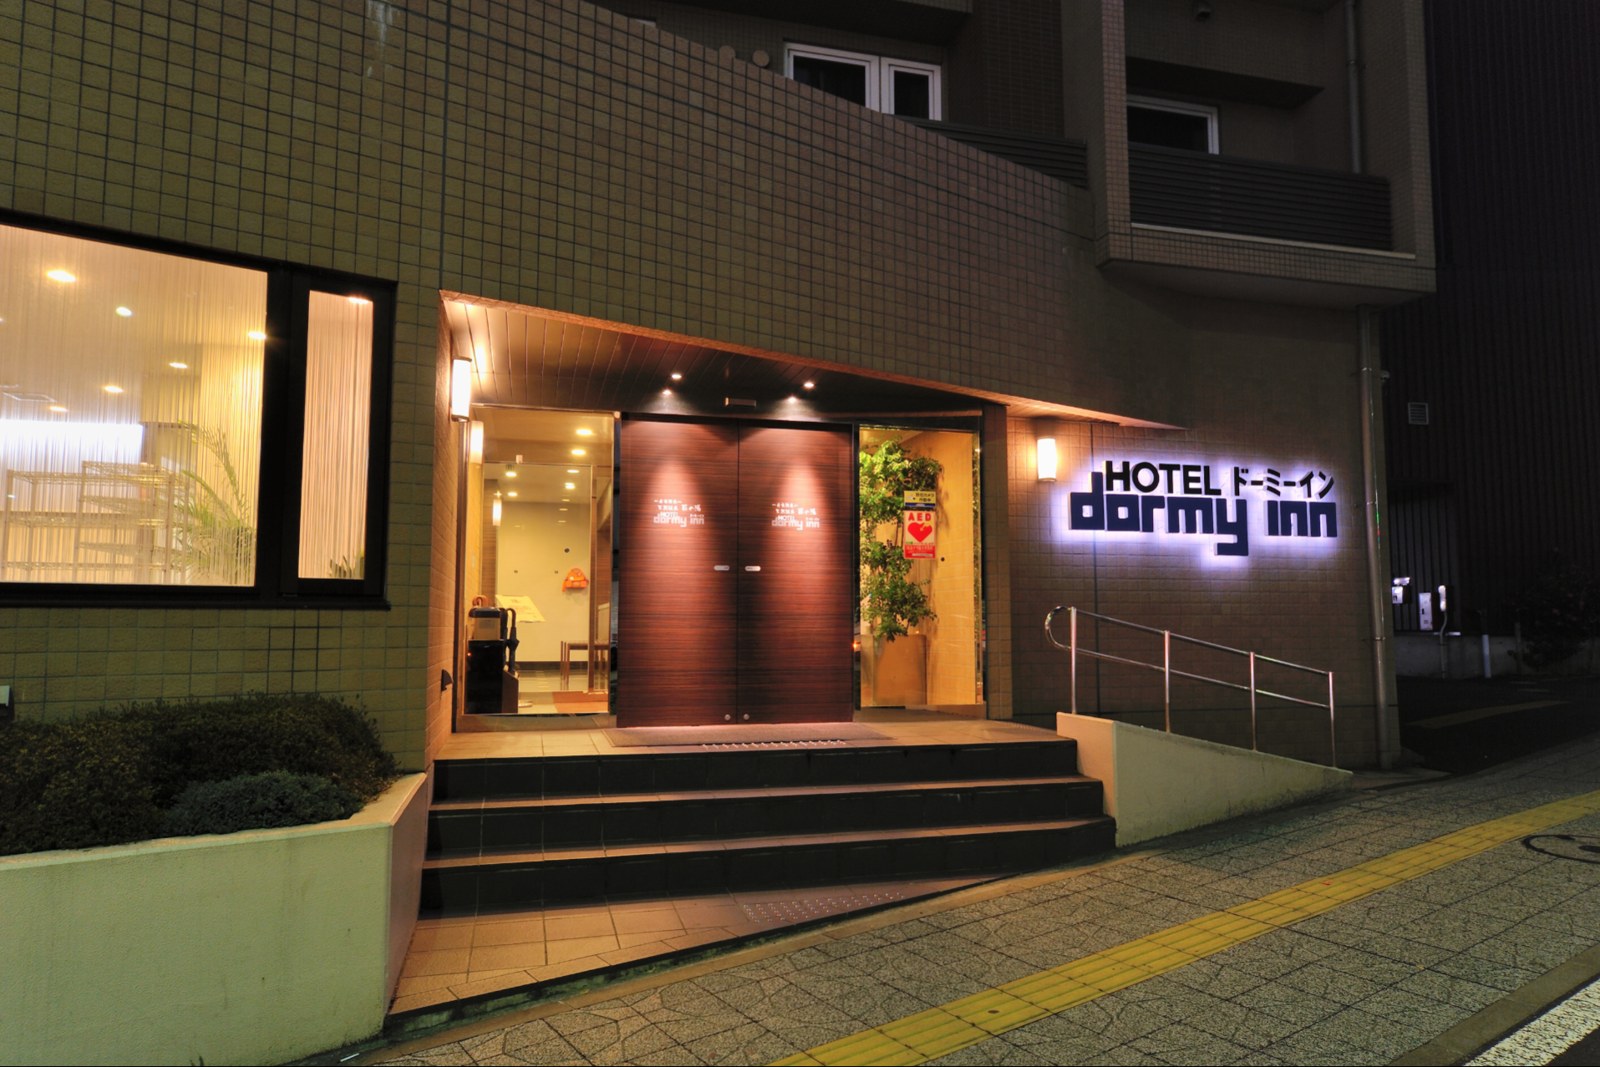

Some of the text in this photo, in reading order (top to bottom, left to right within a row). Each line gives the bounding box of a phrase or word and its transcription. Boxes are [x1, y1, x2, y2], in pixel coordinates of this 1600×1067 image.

[1105, 460, 1222, 496] HOTEL
[1232, 466, 1335, 499] ドーミーイン
[908, 512, 931, 521] AED
[1068, 471, 1337, 556] dormy inn
